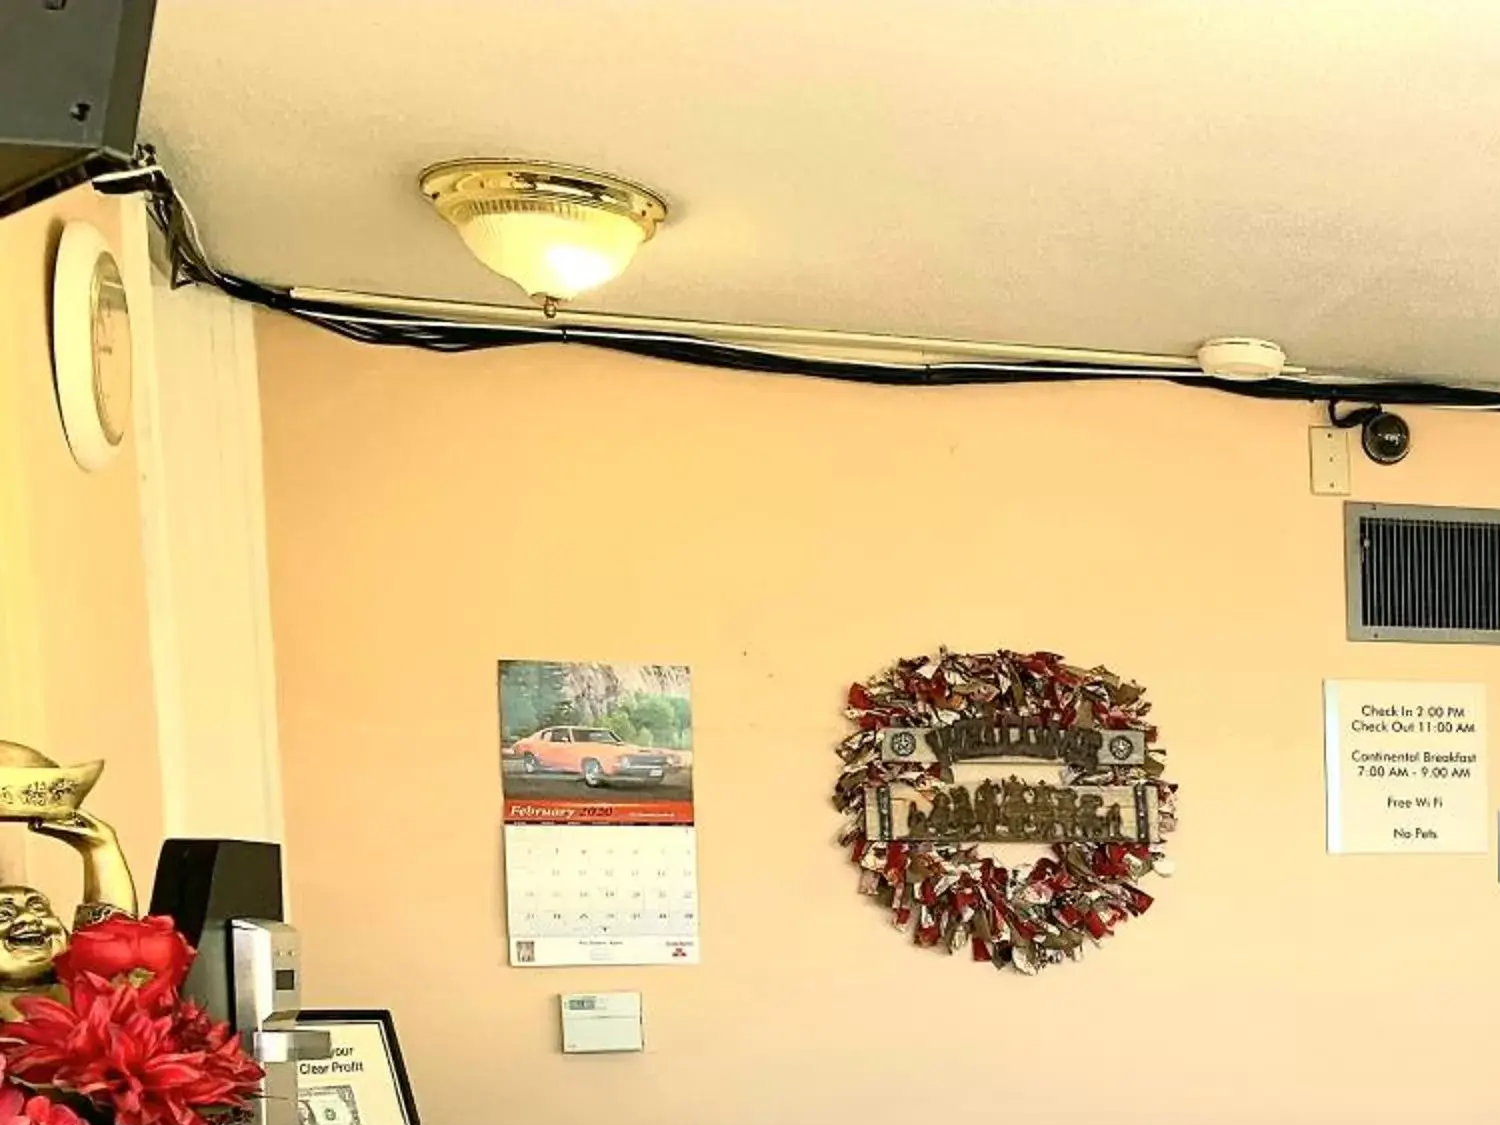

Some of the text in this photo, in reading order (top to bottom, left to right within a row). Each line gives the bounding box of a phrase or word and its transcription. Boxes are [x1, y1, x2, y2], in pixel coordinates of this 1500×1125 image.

[1361, 704, 1465, 718] Check In 200 PM
[1351, 719, 1475, 733] Check Out 11:00 AM
[1351, 749, 1477, 763] Continental Breakfast
[1388, 766, 1409, 777] AM
[1451, 767, 1471, 778] AM
[1387, 796, 1413, 808] Free
[511, 804, 614, 819] February 2020
[1393, 827, 1438, 839] No Pets
[299, 1060, 364, 1075] Clear Profit
